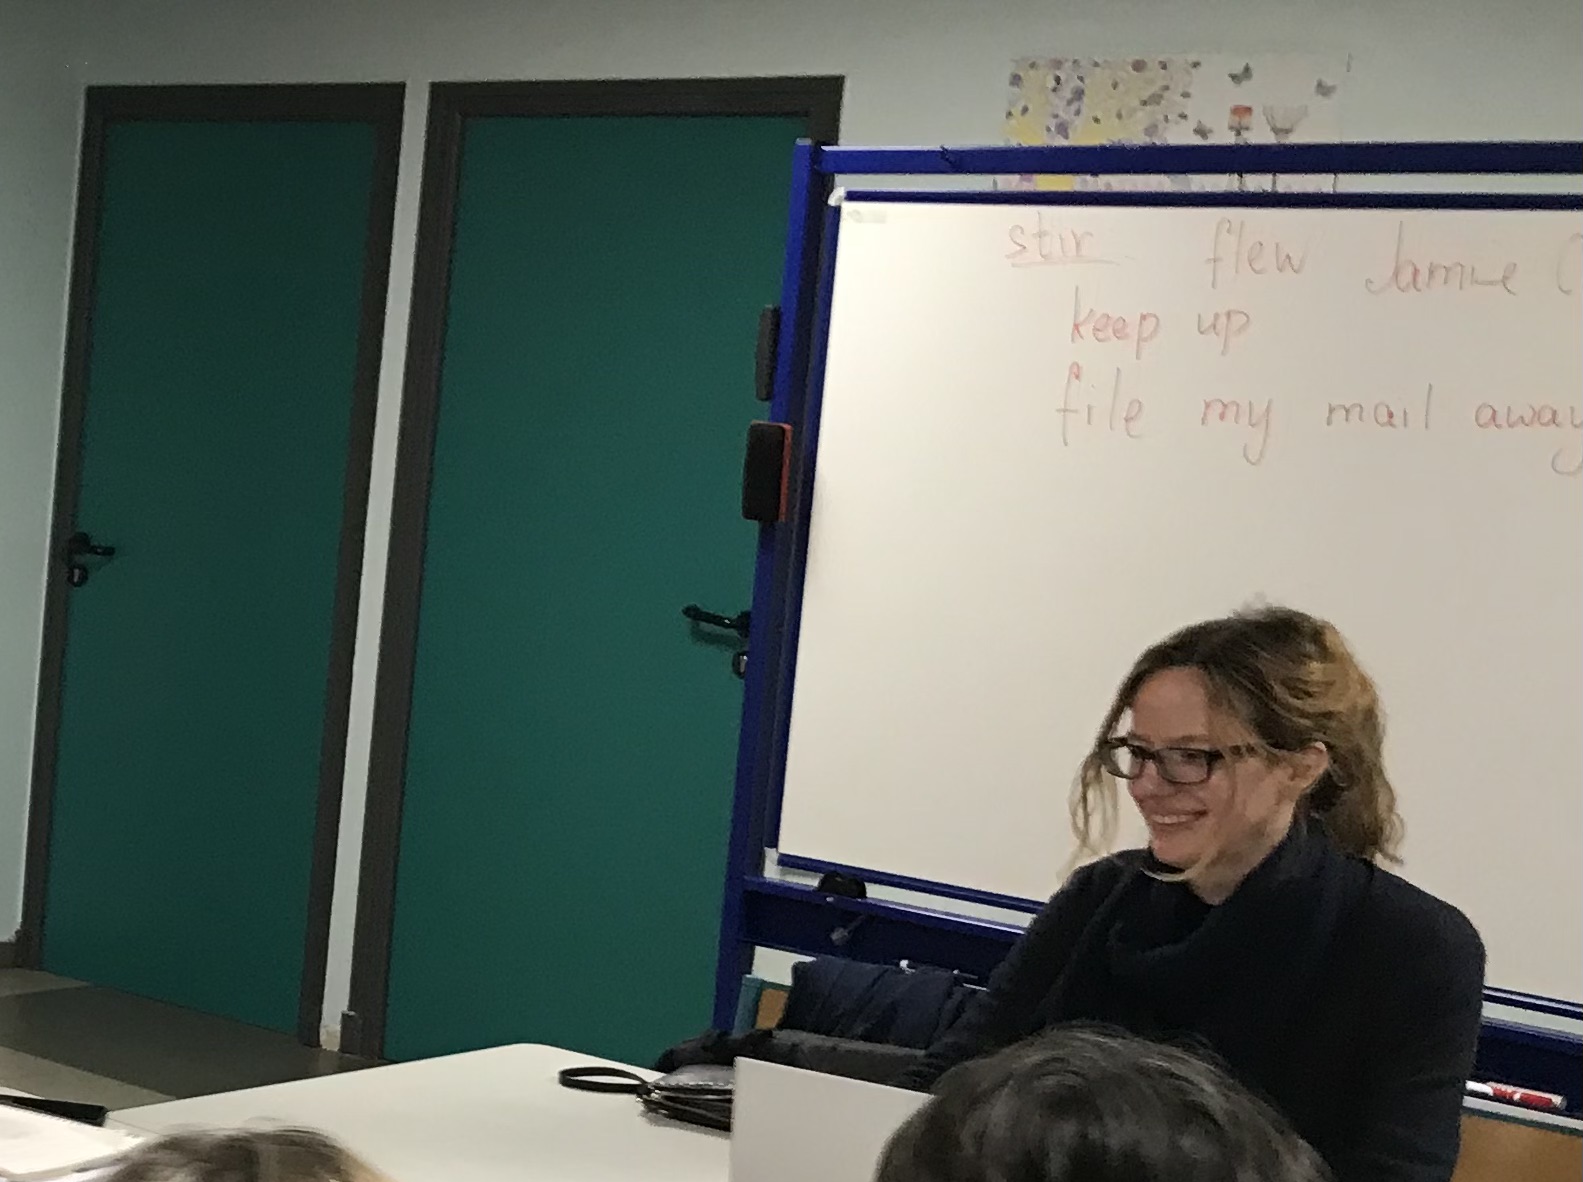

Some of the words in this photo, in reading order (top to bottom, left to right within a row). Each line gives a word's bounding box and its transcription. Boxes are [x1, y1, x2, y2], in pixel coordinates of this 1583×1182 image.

[1005, 211, 1095, 262] stir
[1204, 216, 1308, 290] flew
[1071, 285, 1161, 361] keep
[1197, 309, 1252, 357] up
[1055, 361, 1145, 447] file
[1200, 397, 1274, 467] my
[1325, 383, 1433, 431] mail
